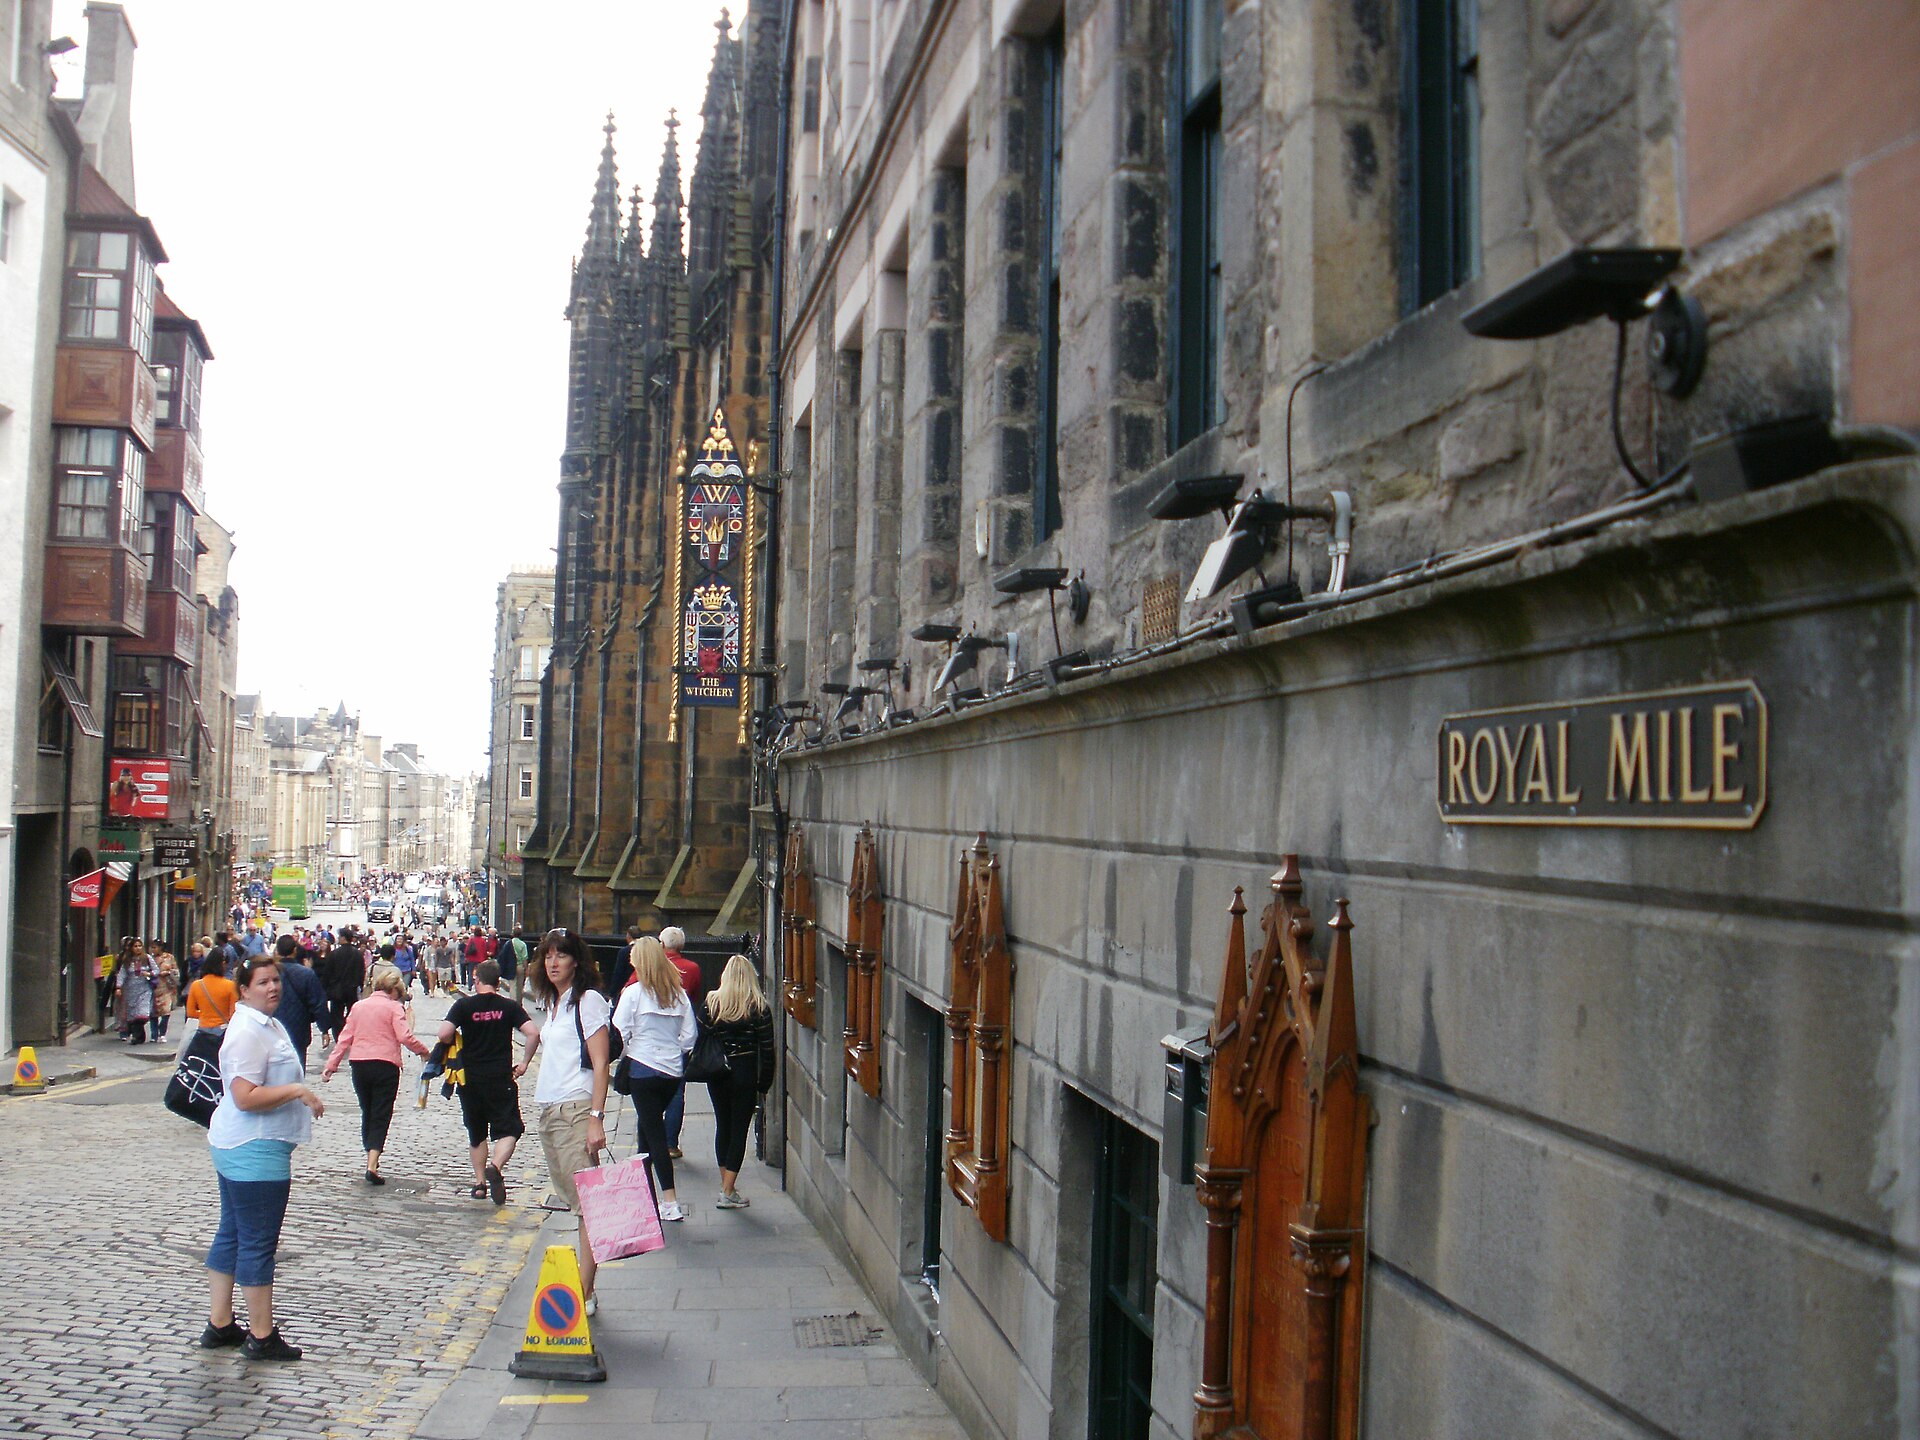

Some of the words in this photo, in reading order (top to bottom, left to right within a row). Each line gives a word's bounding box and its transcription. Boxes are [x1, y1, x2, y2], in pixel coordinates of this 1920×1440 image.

[700, 677, 720, 688] THE
[685, 687, 735, 698] WITCHERY
[1448, 721, 1583, 806] ROYAL
[1606, 702, 1746, 804] MILE
[155, 839, 196, 848] CASTLE
[165, 849, 187, 857] GIFT
[161, 858, 190, 866] SHOP
[472, 1010, 504, 1022] CREW
[525, 1335, 541, 1345] NO
[546, 1336, 588, 1346] LOADING
